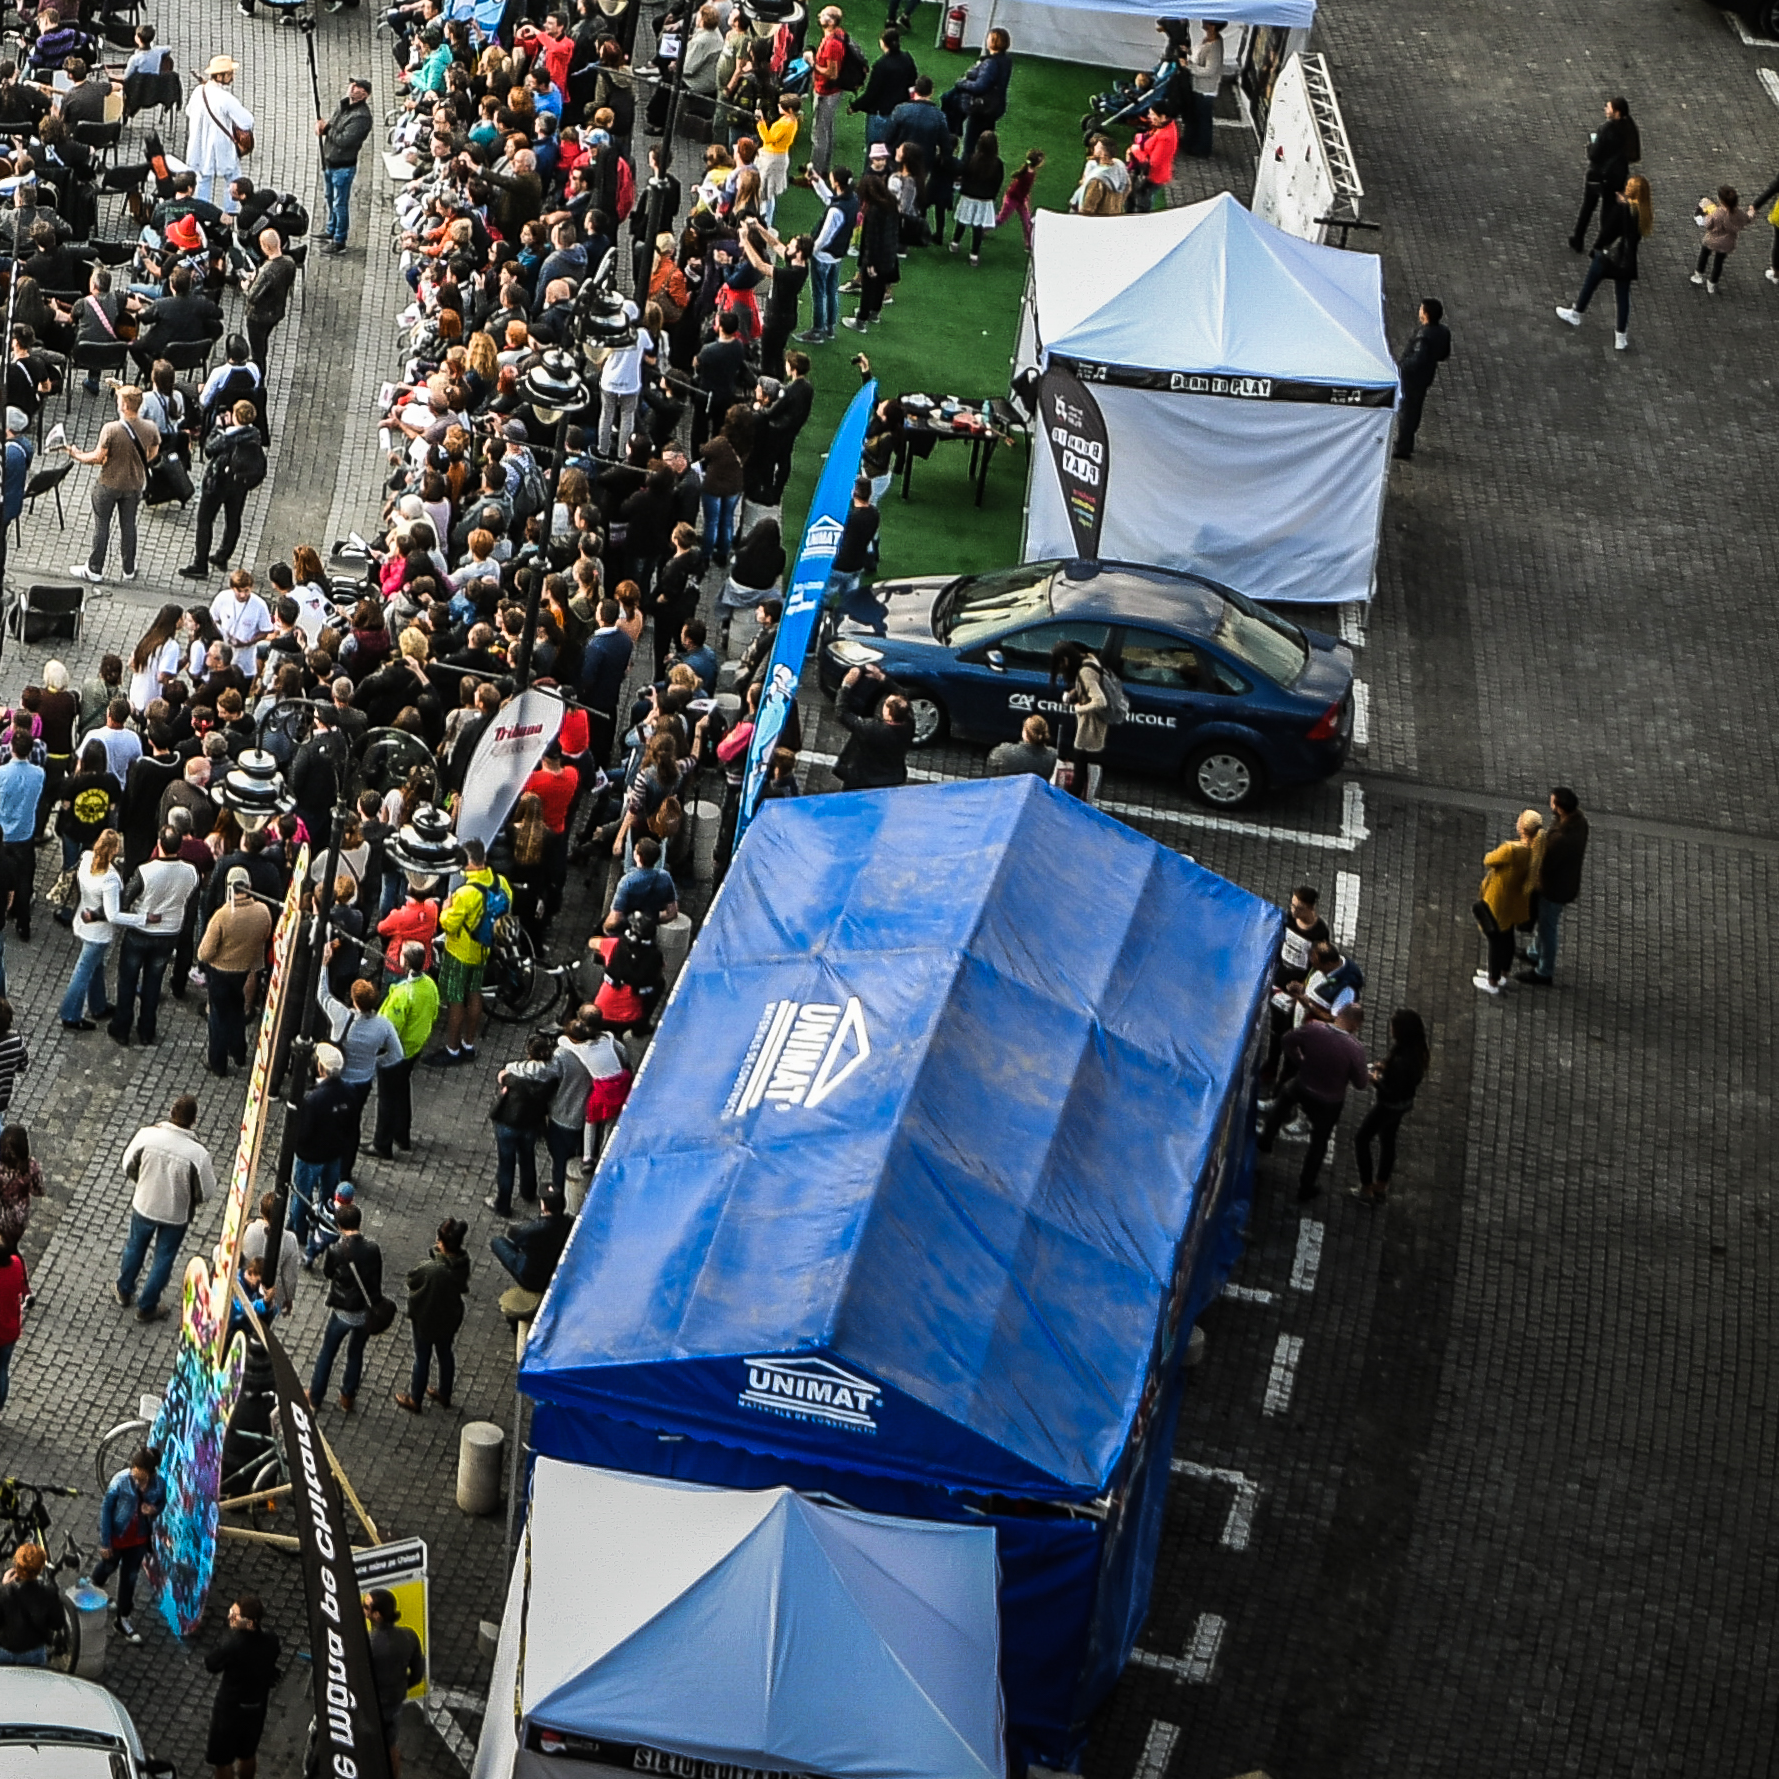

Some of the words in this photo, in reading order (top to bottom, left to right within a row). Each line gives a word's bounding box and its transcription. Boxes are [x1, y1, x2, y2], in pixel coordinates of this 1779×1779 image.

[1212, 378, 1228, 393] TO
[1232, 378, 1270, 397] PLAY
[494, 722, 543, 742] Tribuna
[764, 1002, 842, 1105] UNIMAT
[749, 1367, 874, 1412] UNIMAT
[635, 1749, 697, 1777] SIBIU
